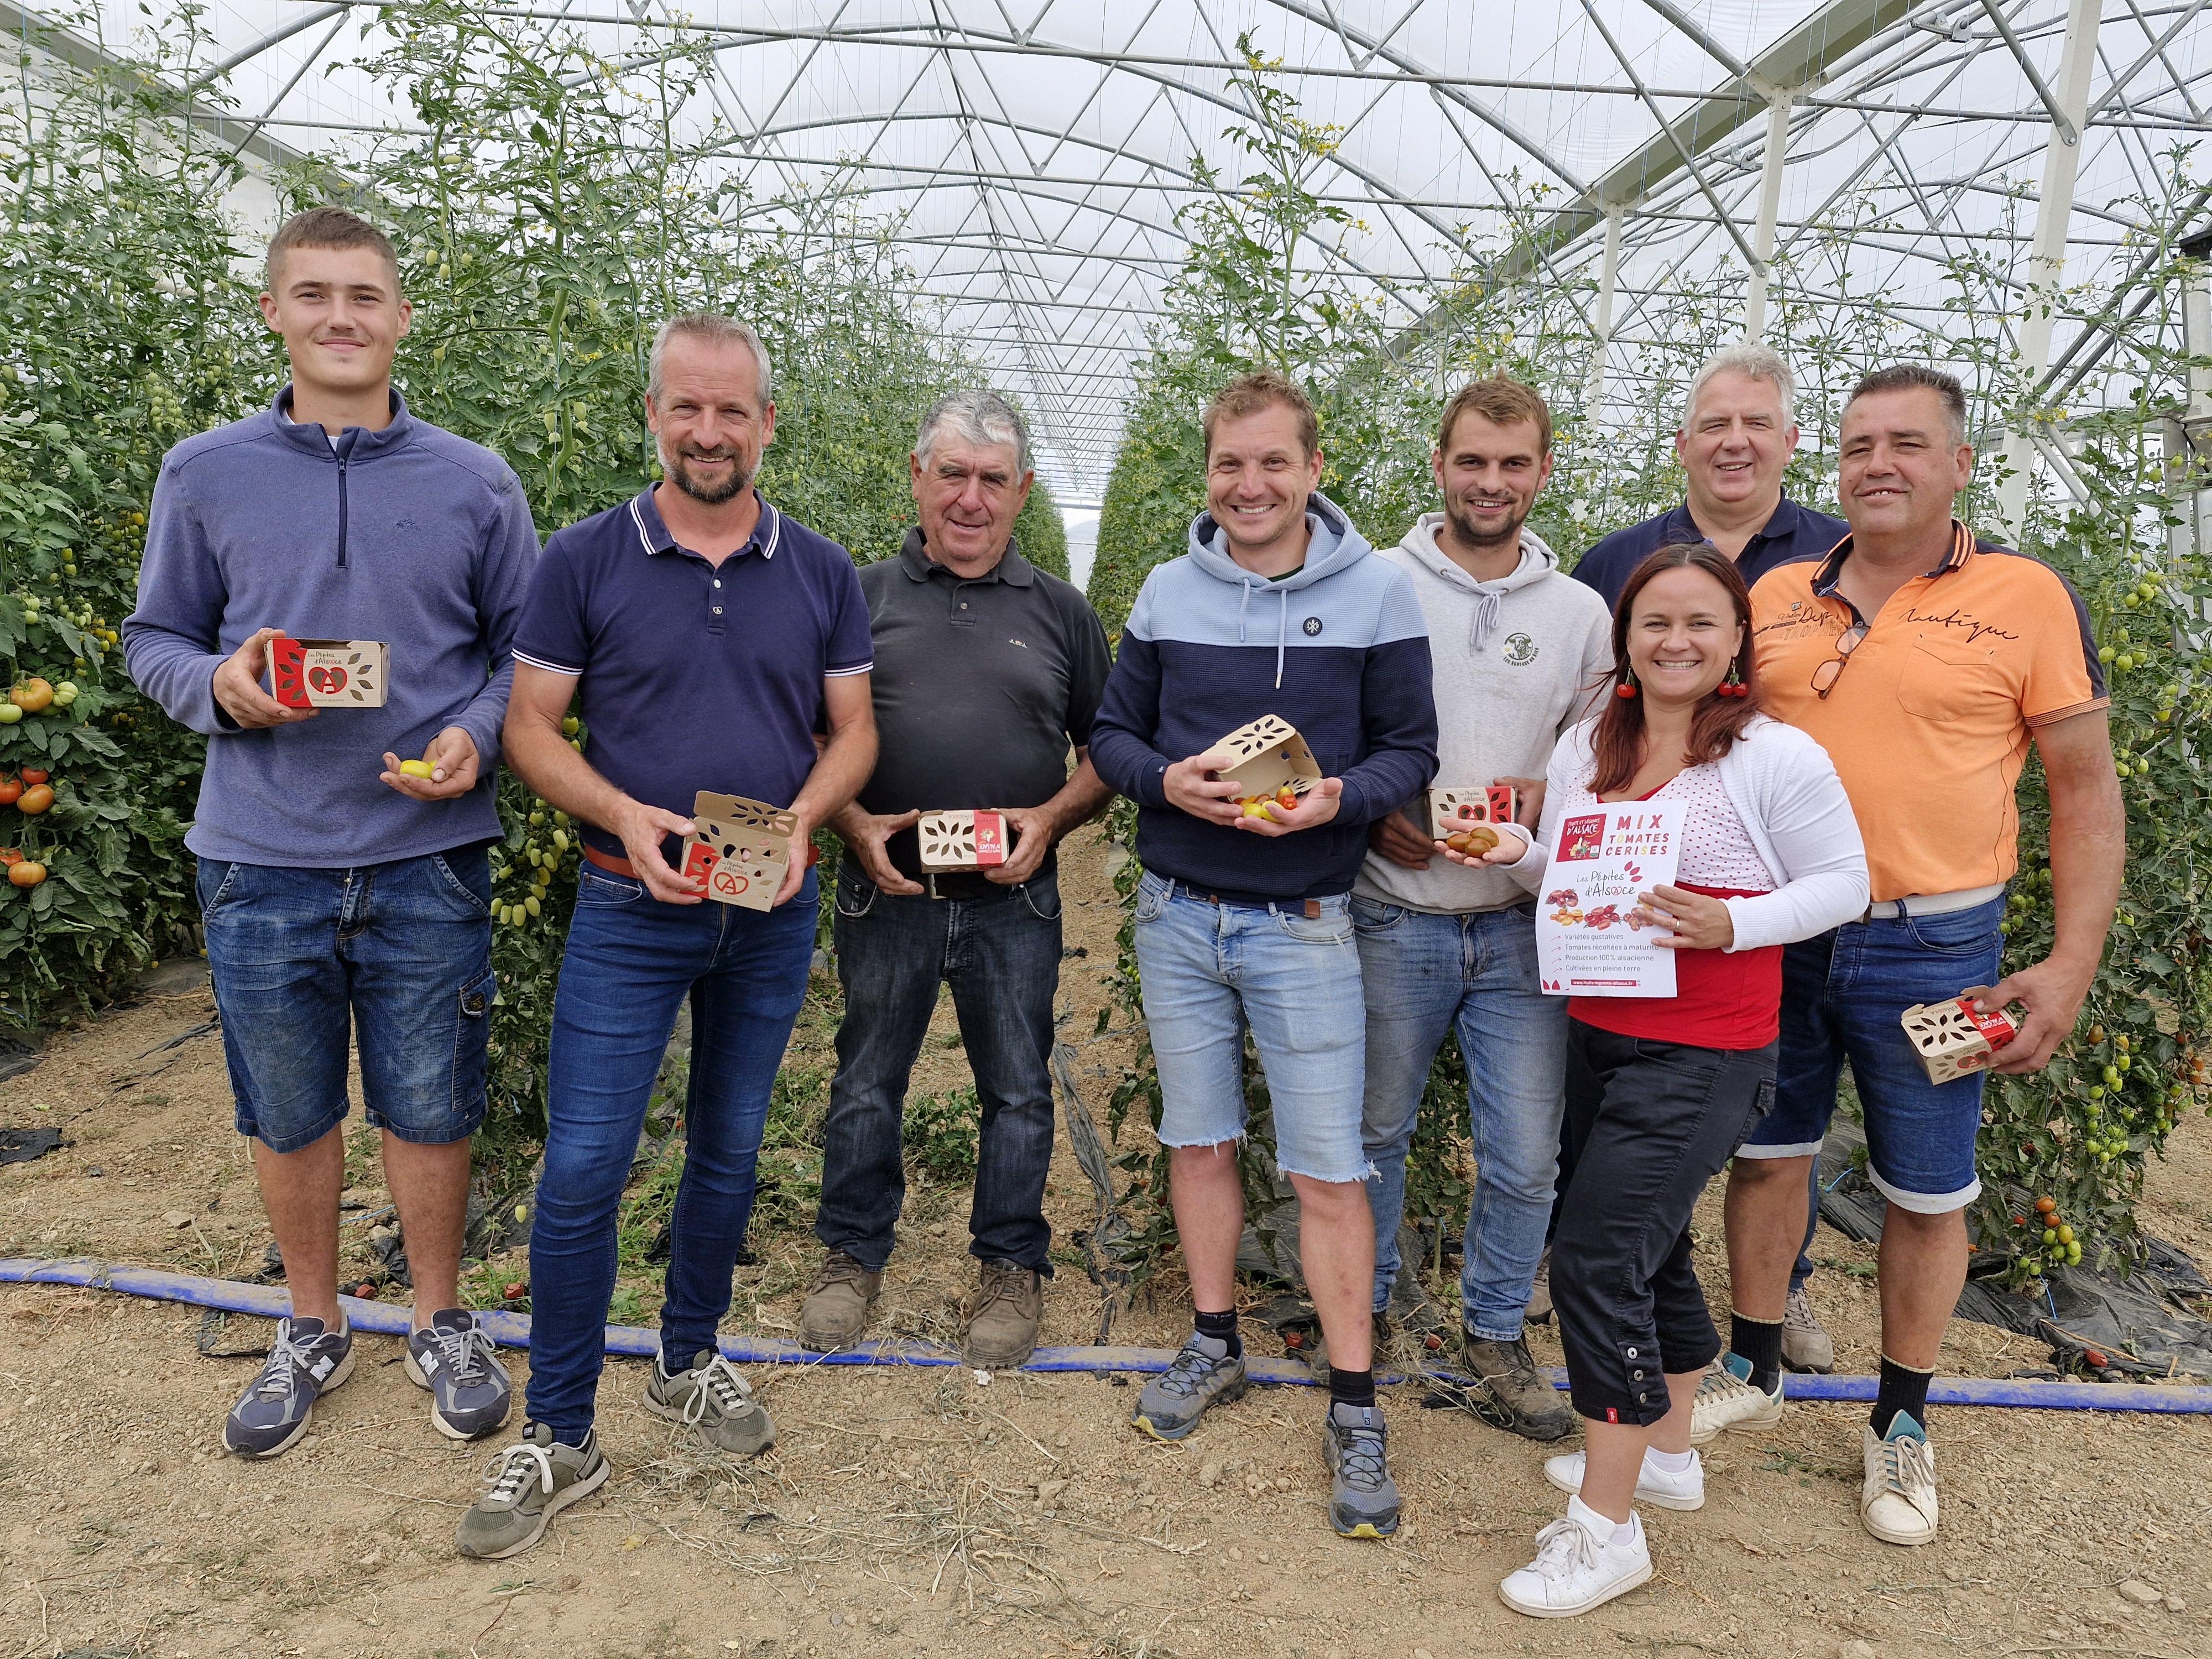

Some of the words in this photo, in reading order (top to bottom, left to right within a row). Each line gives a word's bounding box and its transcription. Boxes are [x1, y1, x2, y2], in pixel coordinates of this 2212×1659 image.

[1616, 814, 1663, 830] MIX
[1567, 823, 1599, 836] D'ALSACE
[1609, 833, 1670, 844] TOMATES
[1605, 845, 1667, 856] CERISES
[1577, 874, 1588, 883] Les
[1591, 869, 1624, 883] Pépites
[418, 1349, 439, 1376] N
